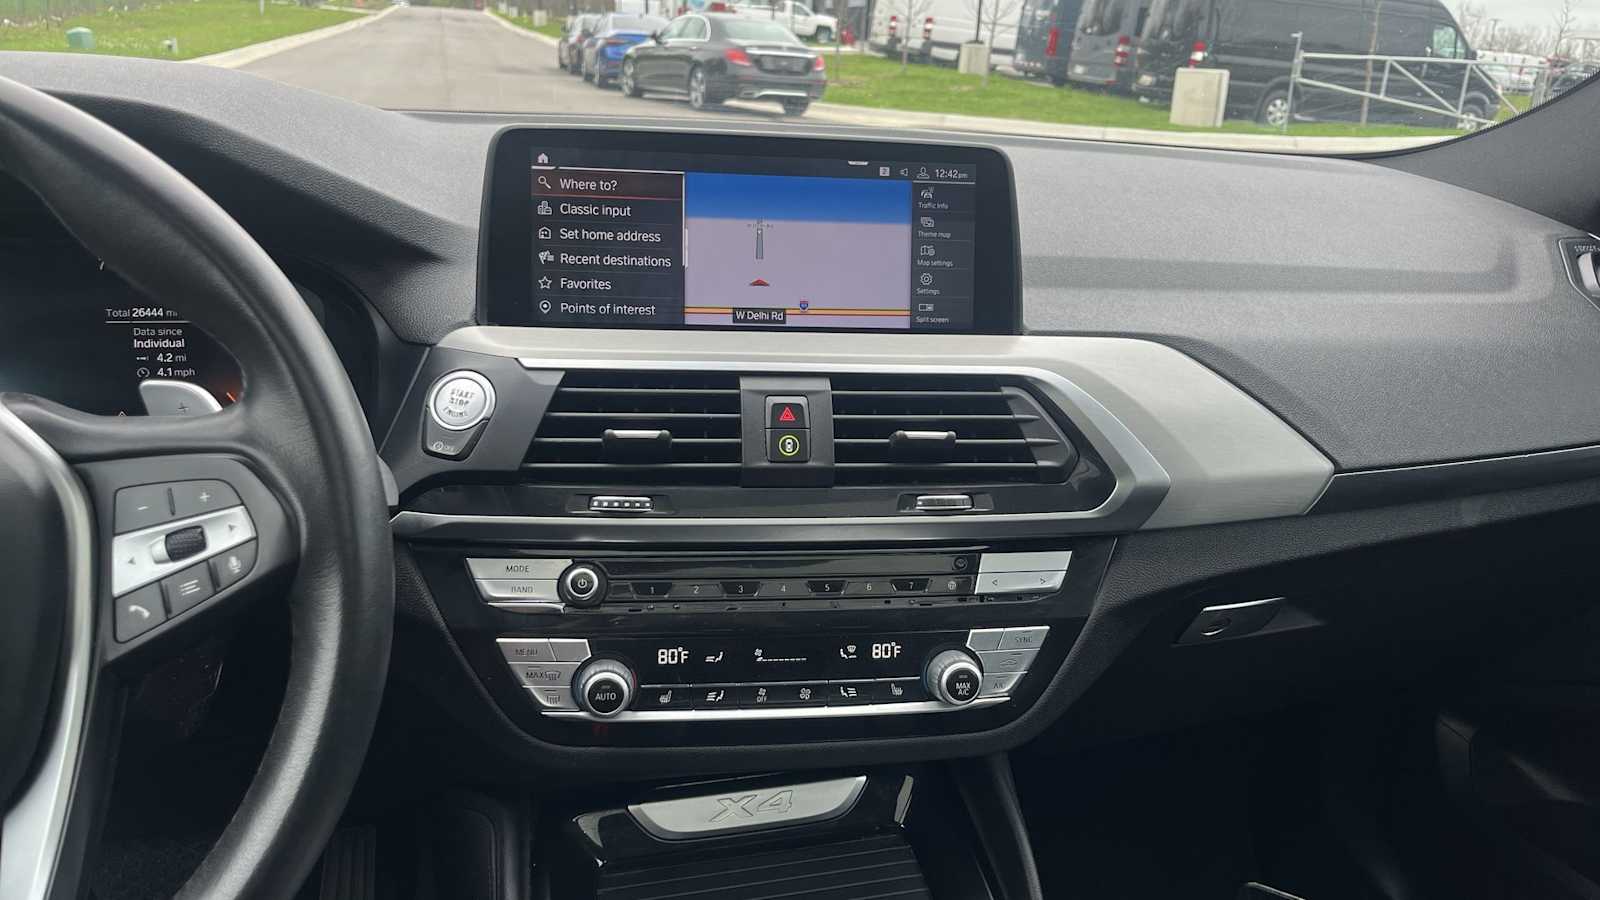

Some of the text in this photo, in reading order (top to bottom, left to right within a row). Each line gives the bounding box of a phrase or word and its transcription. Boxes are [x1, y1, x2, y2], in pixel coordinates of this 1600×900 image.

[559, 178, 618, 191] Where to?
[560, 202, 632, 218] Classic input
[559, 228, 661, 242] Set home address
[560, 253, 672, 267] Recent destinations
[560, 278, 612, 290] Favorites
[106, 308, 130, 317] Total
[132, 307, 163, 317] 26444
[560, 302, 656, 315] Points of interest
[735, 310, 783, 321] W Delhi Rd
[133, 327, 183, 336] Data since
[133, 338, 185, 348] Individual
[156, 353, 187, 362] 4.2 mi
[157, 367, 195, 377] 4.1 mph
[506, 565, 529, 573] MODE
[511, 586, 534, 594] BAND
[650, 581, 914, 594] 1 2 3 4 5 6 7
[515, 648, 538, 656] MENU
[595, 692, 616, 701] AUTO
[709, 789, 793, 823] X4
